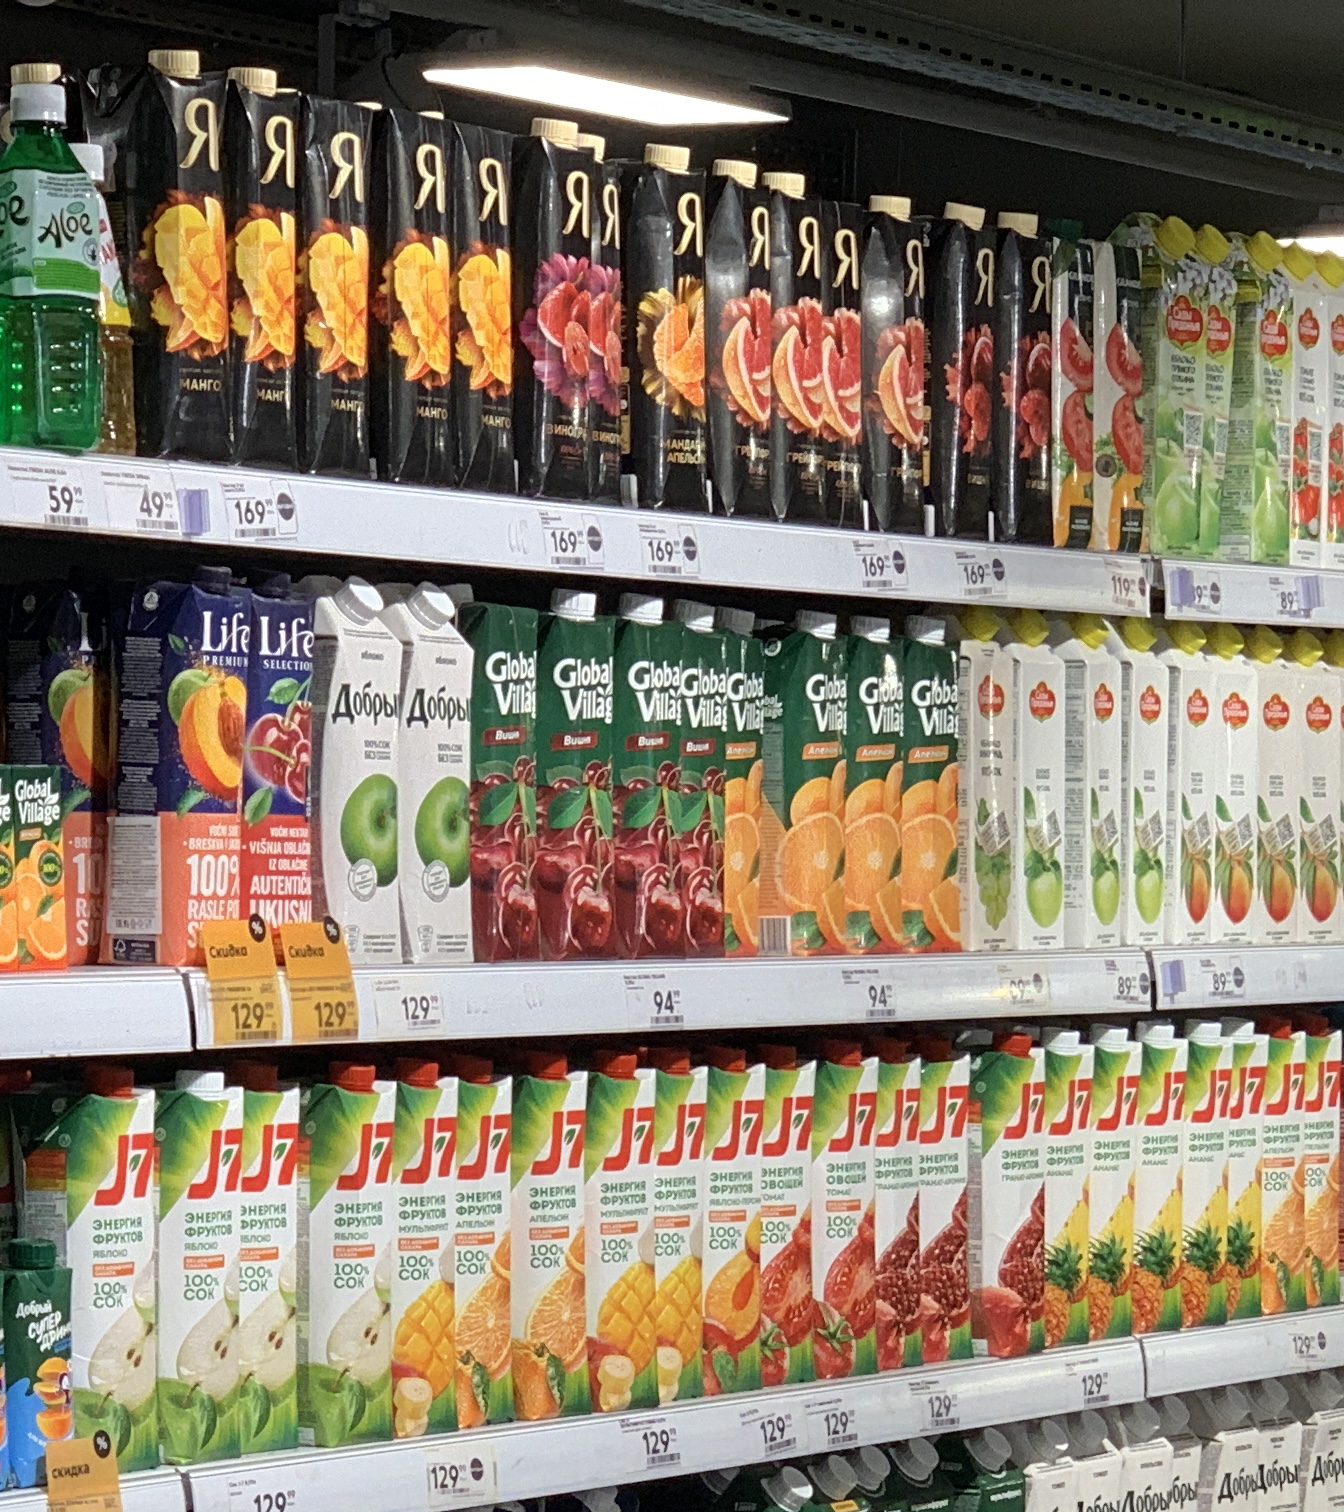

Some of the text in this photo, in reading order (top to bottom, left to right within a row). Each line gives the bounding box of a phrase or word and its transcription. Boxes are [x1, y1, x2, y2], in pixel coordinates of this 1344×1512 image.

[180, 98, 219, 171] Я
[261, 115, 295, 188] Я
[330, 132, 364, 202] Я
[37, 208, 93, 249] Aloe
[180, 377, 222, 393] МАНГО
[49, 486, 73, 514] 59
[139, 490, 165, 518] 49
[234, 499, 266, 525] 169
[551, 530, 576, 554] 169
[201, 611, 250, 653] Life
[259, 616, 314, 658] Life
[263, 659, 313, 671] SELECTIO
[554, 657, 613, 688] Global
[332, 683, 398, 725] Добры
[249, 838, 282, 854] VIŠNJA
[186, 854, 240, 897] 100%
[209, 944, 248, 957] Скидка
[288, 945, 325, 957] Скидка
[402, 997, 431, 1021] 129
[653, 990, 674, 1014] 94
[231, 1005, 265, 1030] 129
[315, 1003, 346, 1028] 129
[828, 1092, 877, 1152] J7
[94, 1132, 155, 1206] J7
[187, 1128, 243, 1200] J7
[92, 1217, 143, 1231] ЭНЕРГИЯ
[92, 1230, 143, 1244] ФРУКТОВ
[92, 1248, 128, 1259] ЯБЛОКО
[93, 1282, 127, 1296] 100%
[93, 1295, 123, 1309] СОК
[1082, 1373, 1102, 1395] 129
[431, 1465, 459, 1489] 129
